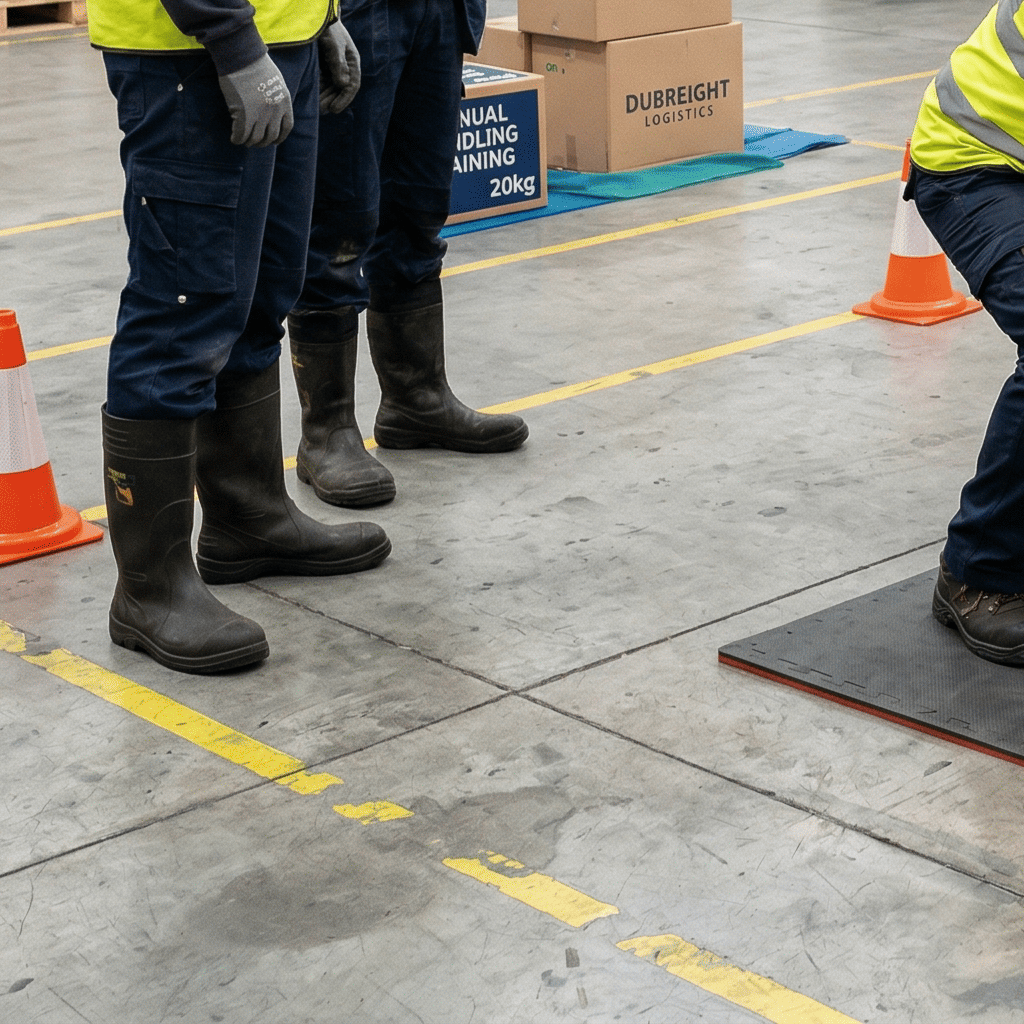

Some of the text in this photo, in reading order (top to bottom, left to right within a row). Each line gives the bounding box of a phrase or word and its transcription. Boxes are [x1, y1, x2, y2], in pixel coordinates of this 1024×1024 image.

[626, 79, 730, 114] DUBREIGHT
[460, 104, 508, 128] NUAL
[645, 105, 713, 127] LOGISTICS
[457, 124, 518, 151] DLING
[453, 147, 516, 173] AINING
[490, 174, 535, 197] 20kg
